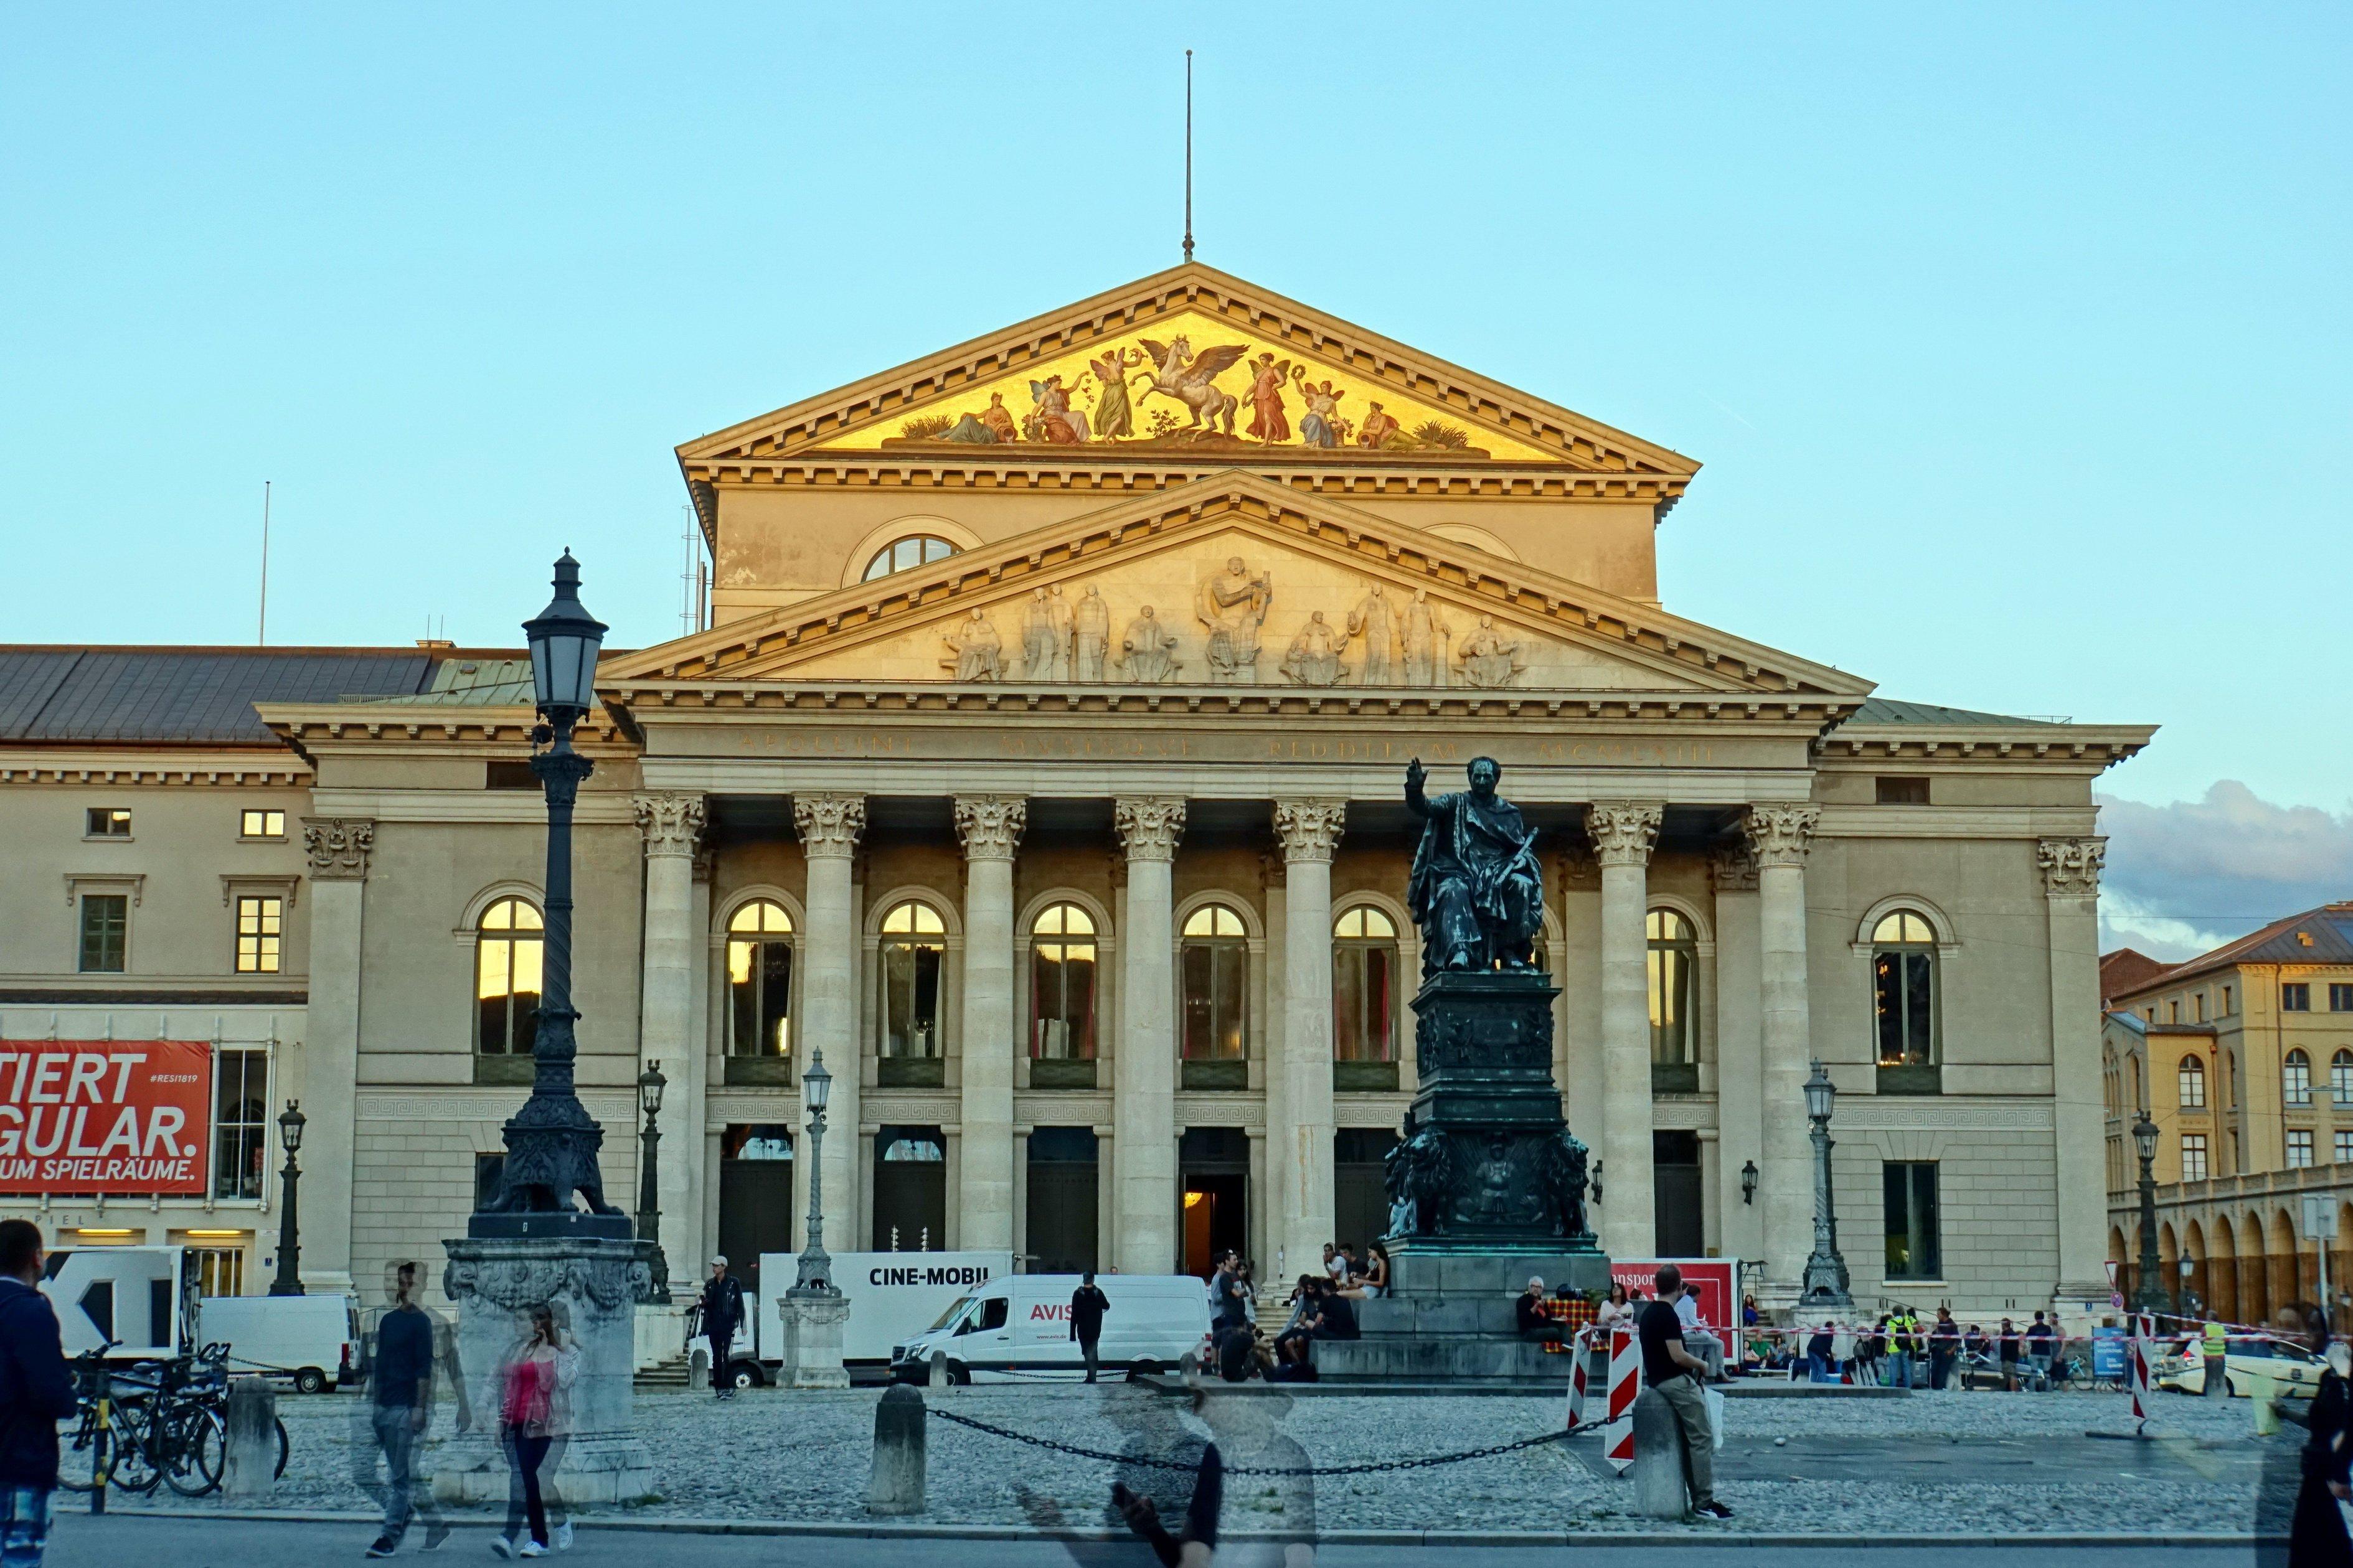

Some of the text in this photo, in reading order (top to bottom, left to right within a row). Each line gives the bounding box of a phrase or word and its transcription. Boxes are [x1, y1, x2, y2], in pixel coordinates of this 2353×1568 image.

[740, 733, 911, 753] APOLLINI
[1270, 741, 1457, 759] REDDITVM
[1538, 743, 1712, 762] MCMLXIII
[149, 1074, 198, 1083] #RESI1819
[0, 1105, 197, 1157] GULAR.
[41, 1157, 196, 1180] SPIELRÄUME.
[1030, 1304, 1072, 1321] AVIS
